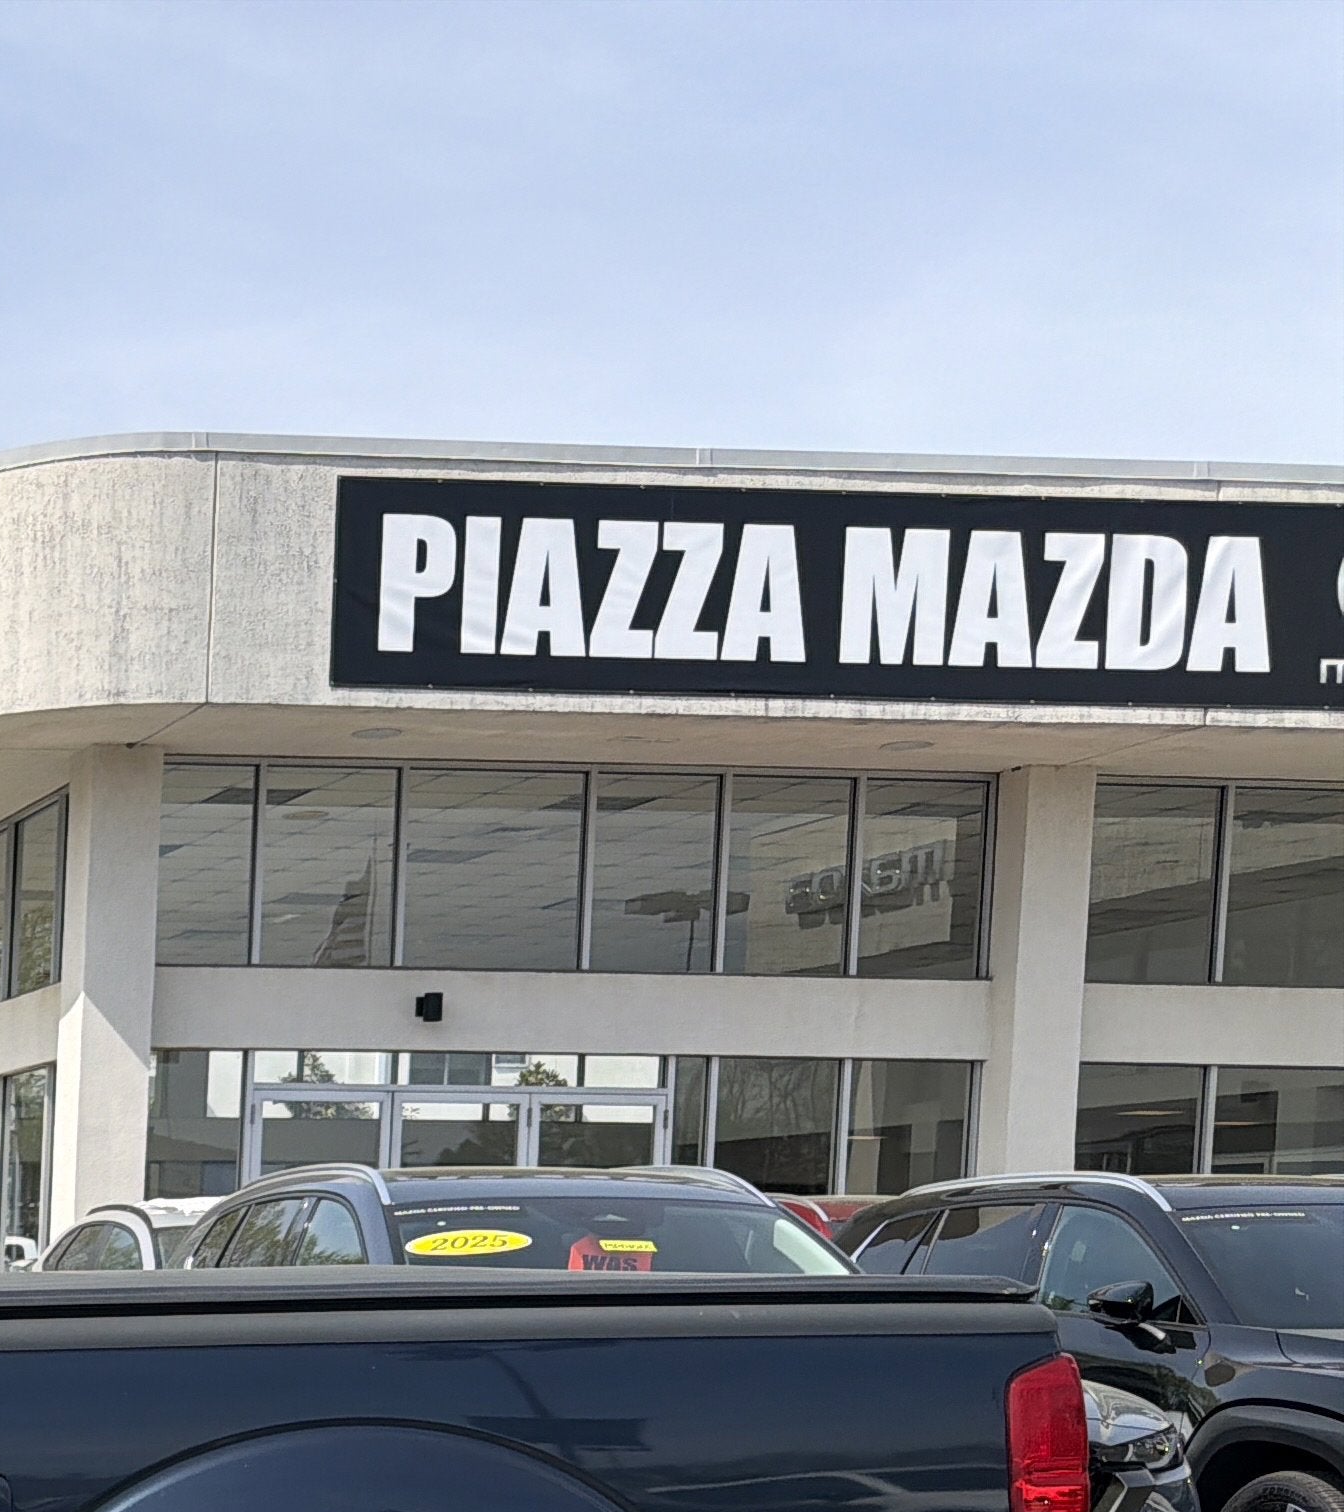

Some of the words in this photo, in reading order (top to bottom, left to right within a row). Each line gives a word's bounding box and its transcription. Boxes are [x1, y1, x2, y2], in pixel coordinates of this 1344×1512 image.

[377, 513, 807, 663] PIAZZA
[838, 526, 1272, 673] MAZDA
[430, 1234, 509, 1252] 2025
